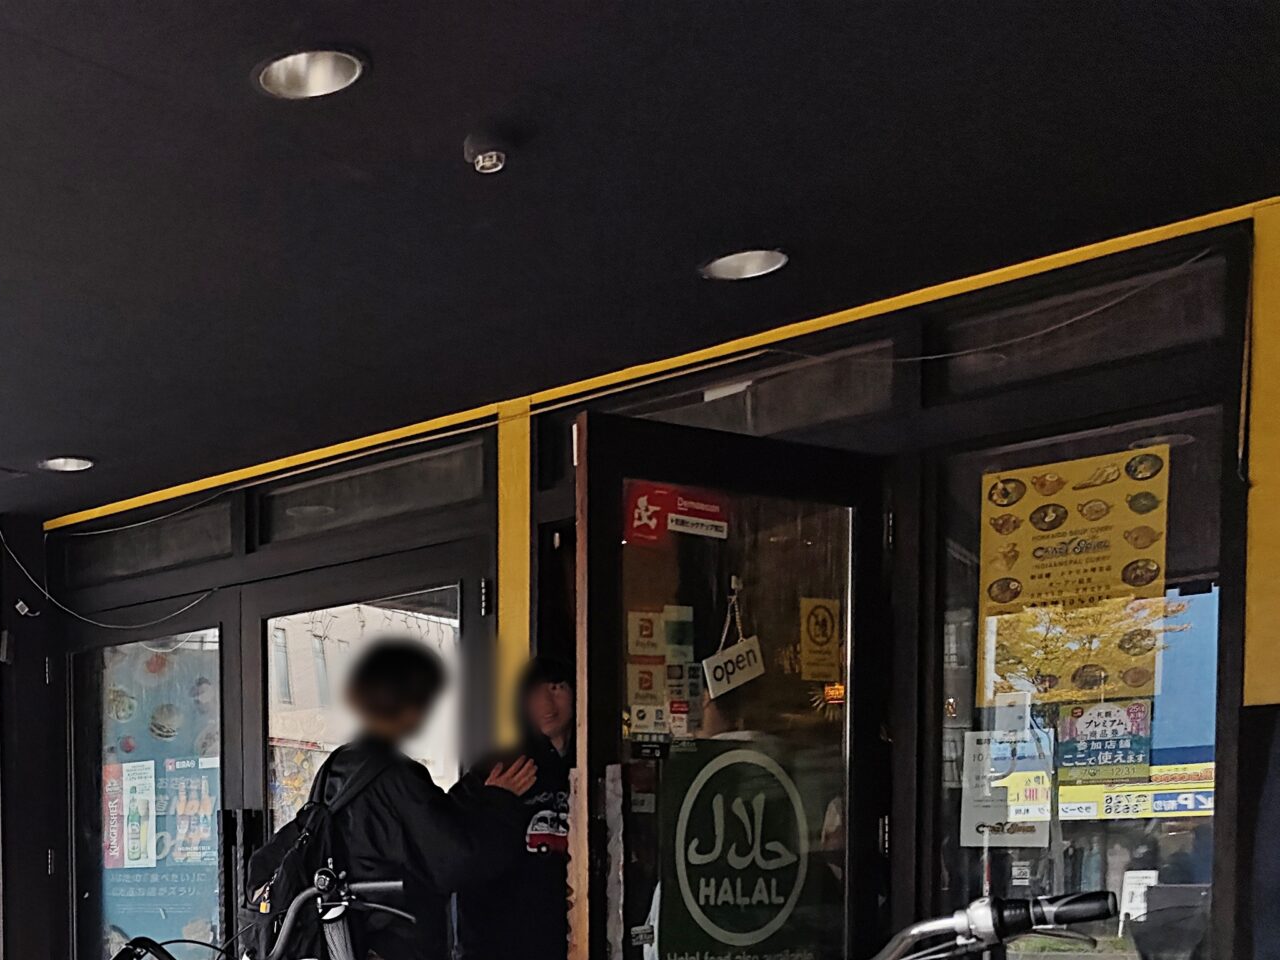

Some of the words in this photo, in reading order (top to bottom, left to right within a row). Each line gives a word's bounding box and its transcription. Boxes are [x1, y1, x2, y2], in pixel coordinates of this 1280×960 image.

[712, 647, 758, 684] open
[1085, 719, 1124, 729] プレミアム
[1077, 739, 1131, 751] 参加店舗
[1062, 750, 1146, 767] ここで使えます
[686, 793, 798, 870] حلال
[699, 877, 785, 906] HALAL
